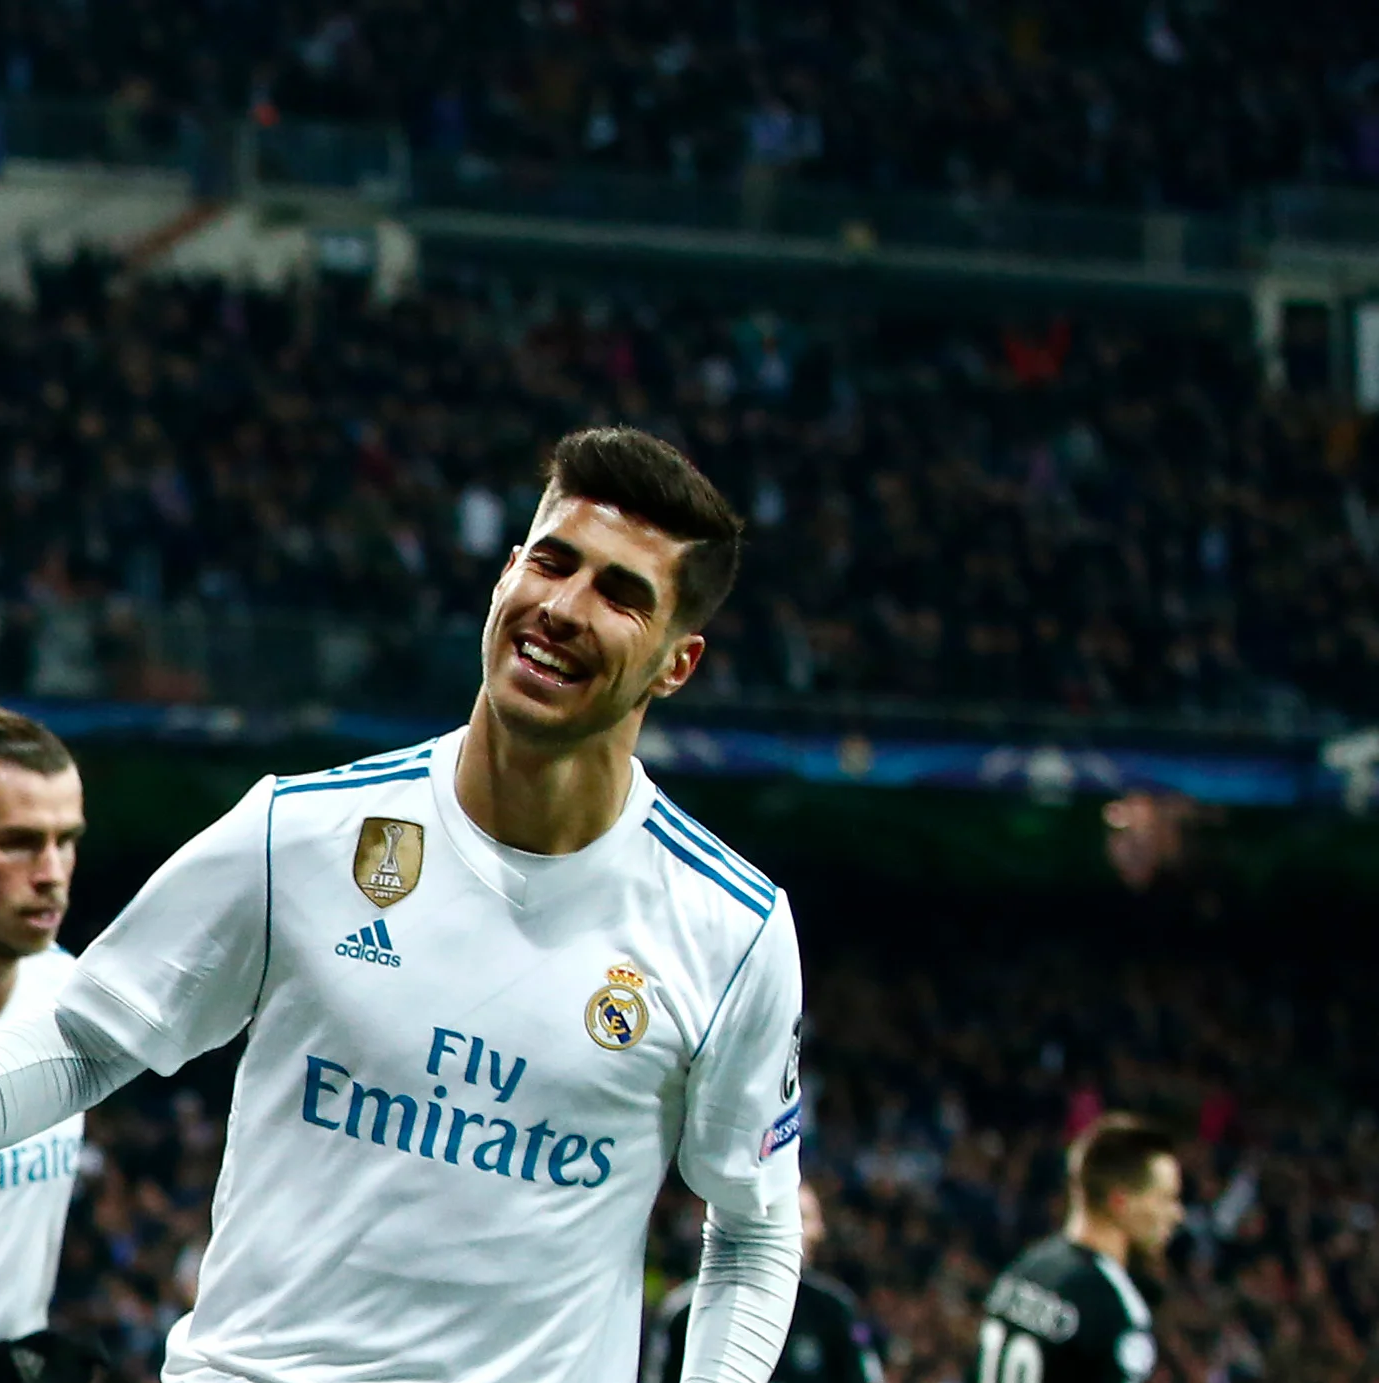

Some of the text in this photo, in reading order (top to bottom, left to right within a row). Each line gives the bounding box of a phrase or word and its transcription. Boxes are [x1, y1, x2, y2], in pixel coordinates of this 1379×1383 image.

[370, 872, 402, 888] FIFA
[335, 941, 401, 969] adidas
[426, 1026, 527, 1103] Fly
[302, 1054, 616, 1188] Emirates
